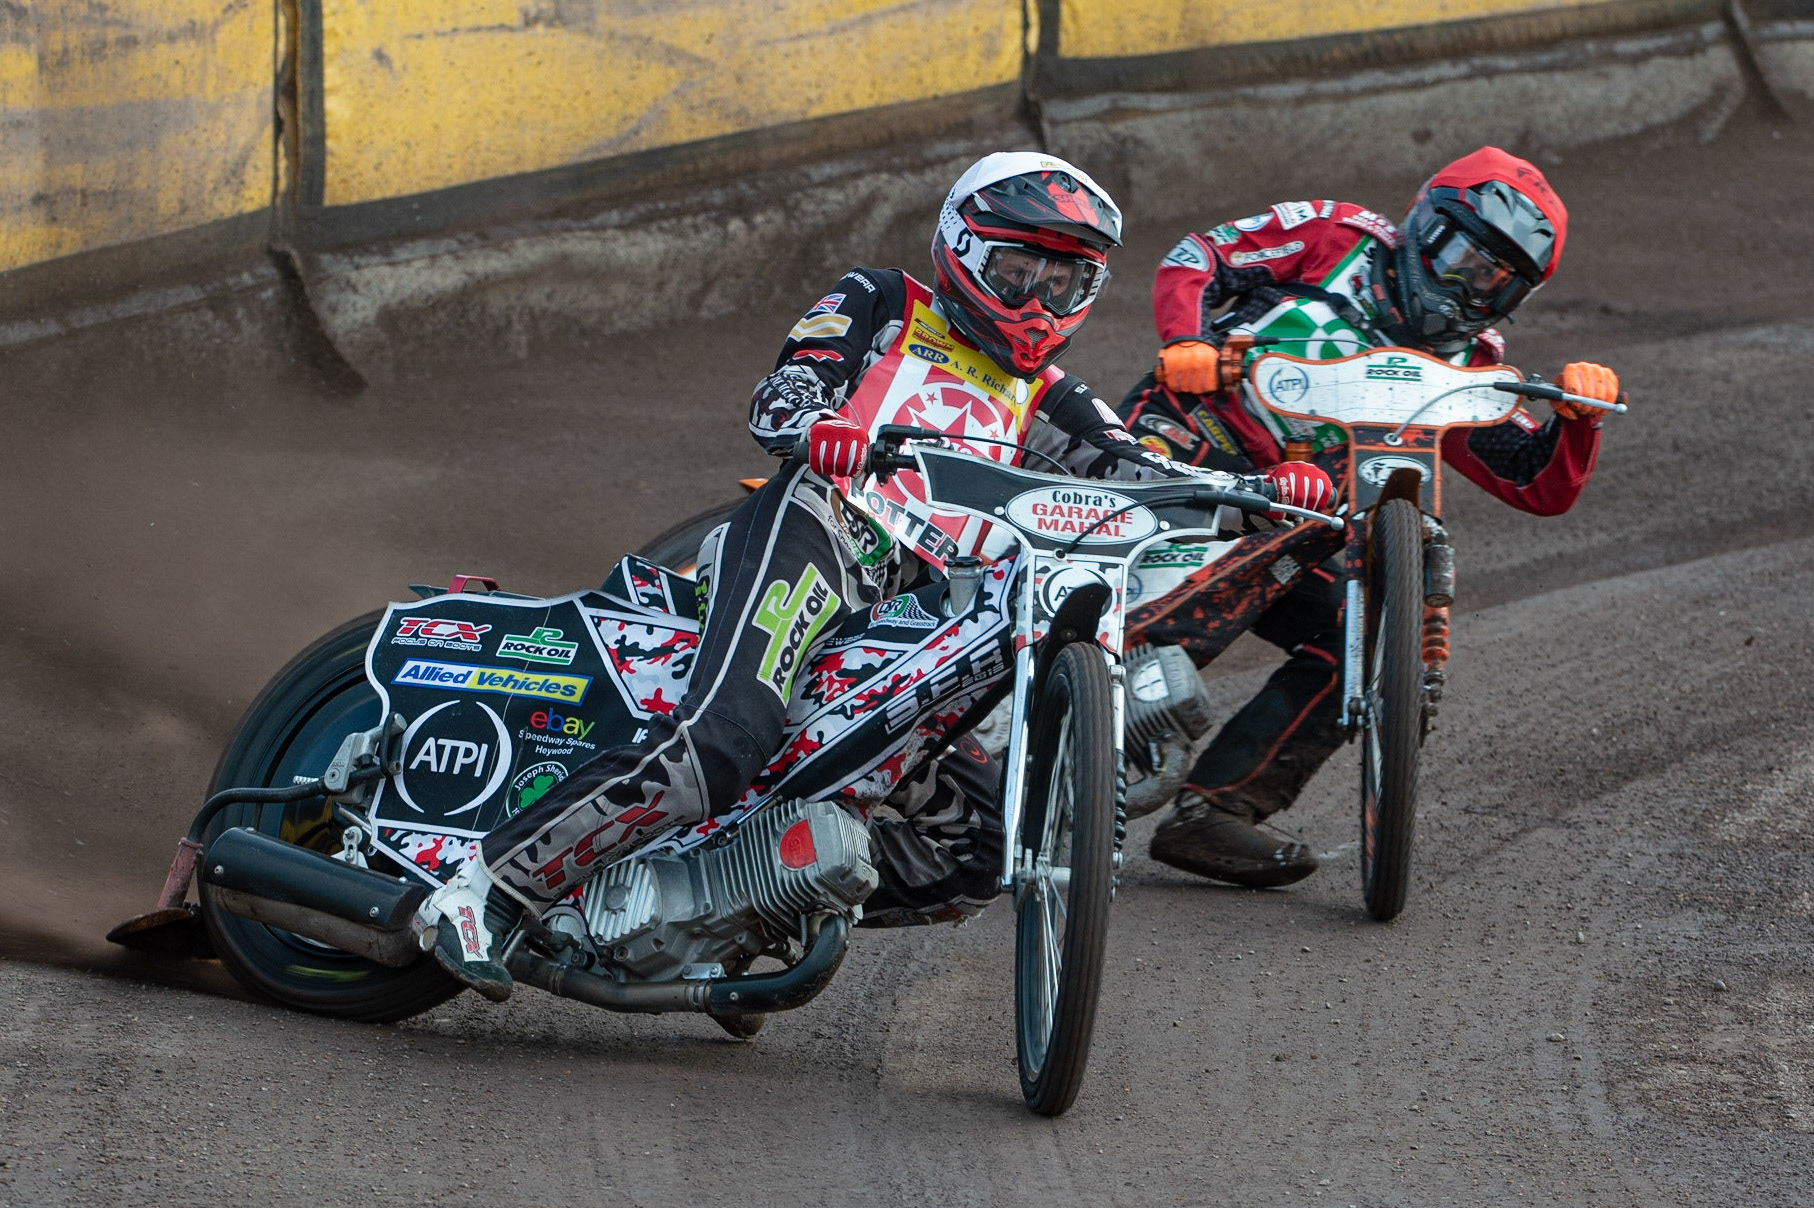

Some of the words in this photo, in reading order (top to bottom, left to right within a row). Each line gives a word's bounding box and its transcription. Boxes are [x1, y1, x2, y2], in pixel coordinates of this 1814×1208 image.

[911, 347, 945, 363] ARR
[1366, 368, 1401, 377] ROCK
[1403, 370, 1423, 378] OIL
[1052, 490, 1116, 508] Cobra's
[397, 617, 492, 643] TCX
[770, 616, 811, 692] ROCK
[807, 580, 830, 617] OIL
[501, 642, 545, 656] ROCK
[546, 647, 573, 660] OIL
[401, 664, 473, 684] Allied
[476, 671, 578, 697] Vehicles
[530, 707, 596, 740] ebay
[518, 729, 566, 746] Speedway
[565, 737, 596, 750] Spares
[535, 744, 574, 757] Heywood
[409, 736, 489, 778] ATPI
[514, 766, 544, 792] Joseph
[532, 790, 669, 890] TCX
